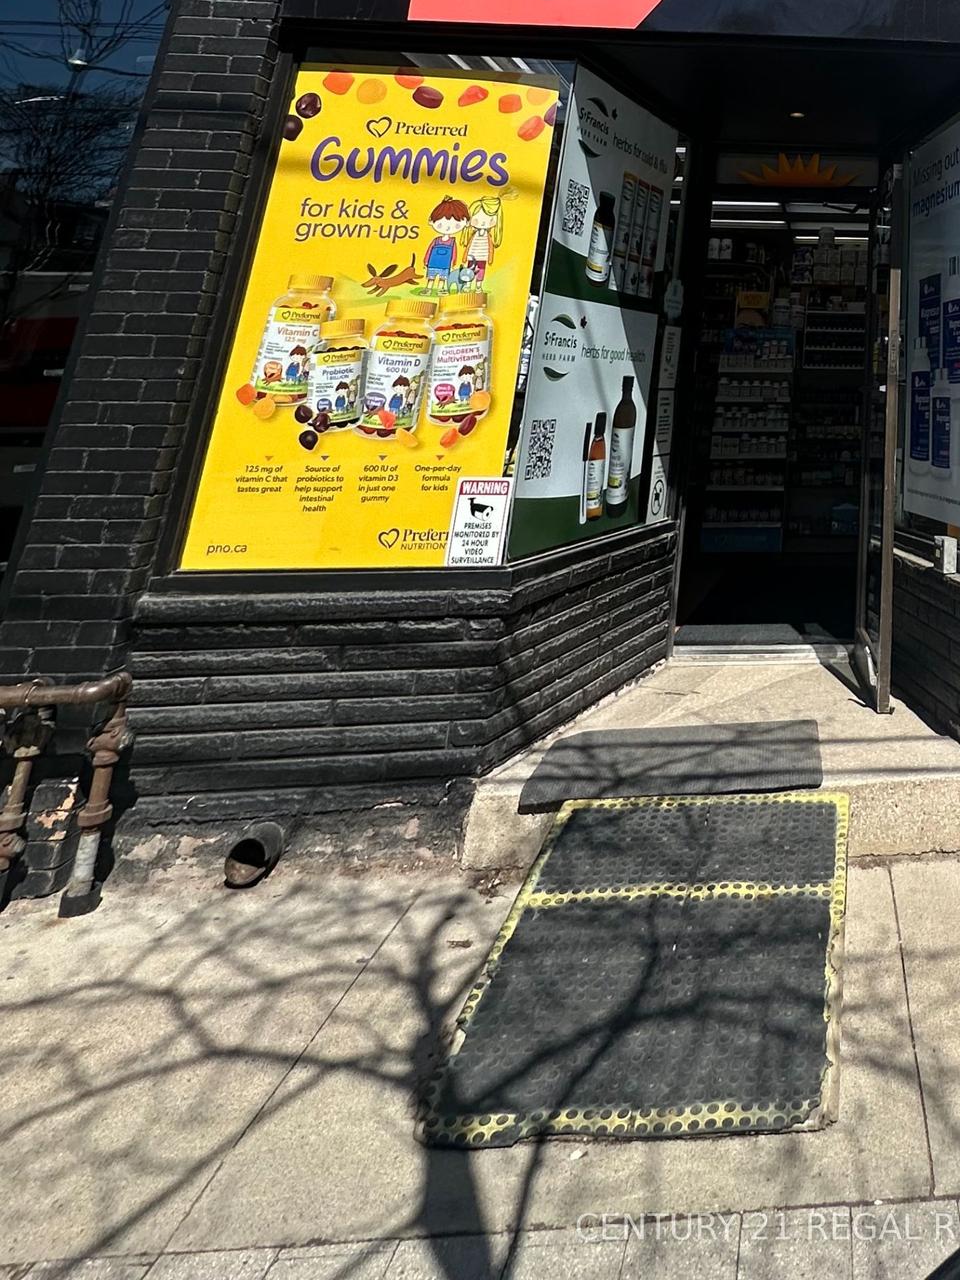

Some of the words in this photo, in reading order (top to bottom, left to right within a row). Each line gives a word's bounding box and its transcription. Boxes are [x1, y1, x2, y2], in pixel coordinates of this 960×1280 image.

[394, 121, 468, 138] Preferred
[311, 136, 509, 187] Gummies
[912, 159, 943, 186] Missing
[944, 148, 960, 171] out
[300, 197, 334, 219] for
[338, 198, 385, 219] kids
[390, 200, 409, 220] &
[295, 222, 420, 245] grown-ups
[277, 326, 310, 337] Vitamin
[312, 329, 319, 337] C
[558, 354, 576, 362] FARM
[581, 343, 600, 358] herbs
[600, 345, 610, 359] for
[609, 347, 625, 364] good
[378, 356, 412, 367] Vitamin
[414, 358, 421, 367] D
[437, 353, 484, 364] Multivitamin
[322, 366, 354, 376] Probiotic
[245, 464, 260, 473] 125
[260, 466, 273, 475] mg
[274, 464, 283, 473] of
[304, 464, 331, 473] Source
[332, 464, 341, 473] of
[363, 464, 379, 473] 600
[389, 464, 398, 473] of
[414, 464, 462, 474] One-per-day
[235, 474, 264, 483] vitamin
[265, 475, 272, 483] C
[272, 475, 288, 483] that
[296, 474, 335, 484] probiotics
[358, 474, 386, 482] vitamin
[387, 474, 399, 482] D3
[422, 474, 451, 482] formula
[237, 485, 260, 493] tastes
[261, 486, 282, 494] great
[294, 484, 312, 494] help
[313, 485, 343, 493] support
[358, 483, 365, 492] in
[365, 484, 380, 493] just
[421, 483, 431, 492] for
[432, 483, 449, 492] kids
[462, 481, 508, 495] WARNING
[299, 494, 335, 502] intestinal
[360, 494, 389, 503] gummy
[302, 504, 327, 512] health
[463, 522, 492, 530] PREMISES
[454, 530, 491, 538] MONITORED
[400, 542, 447, 551] NUTRITION
[470, 539, 489, 547] HOUR
[206, 543, 248, 556] pno.ca
[464, 547, 484, 555] VIDEO
[450, 556, 495, 564] SURVEILLANCE
